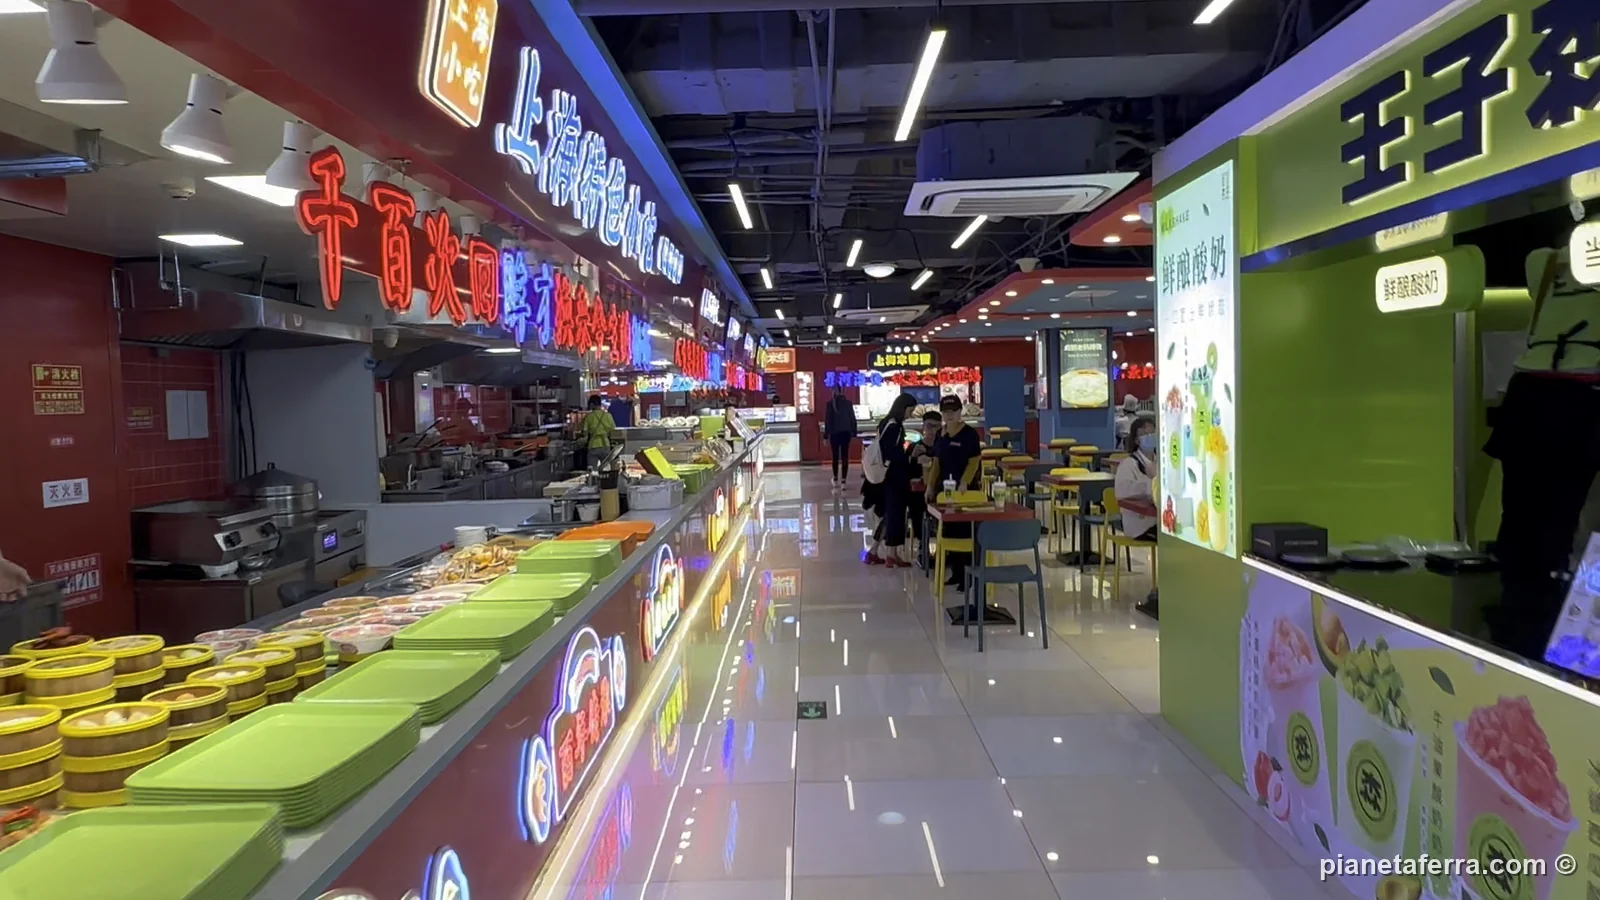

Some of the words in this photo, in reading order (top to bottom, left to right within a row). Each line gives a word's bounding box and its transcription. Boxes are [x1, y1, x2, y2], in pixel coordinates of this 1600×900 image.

[441, 41, 483, 107] 小吃
[1162, 234, 1227, 295] 鲜酿酸奶
[52, 368, 79, 380] 消火栓
[49, 482, 83, 499] 灭火器
